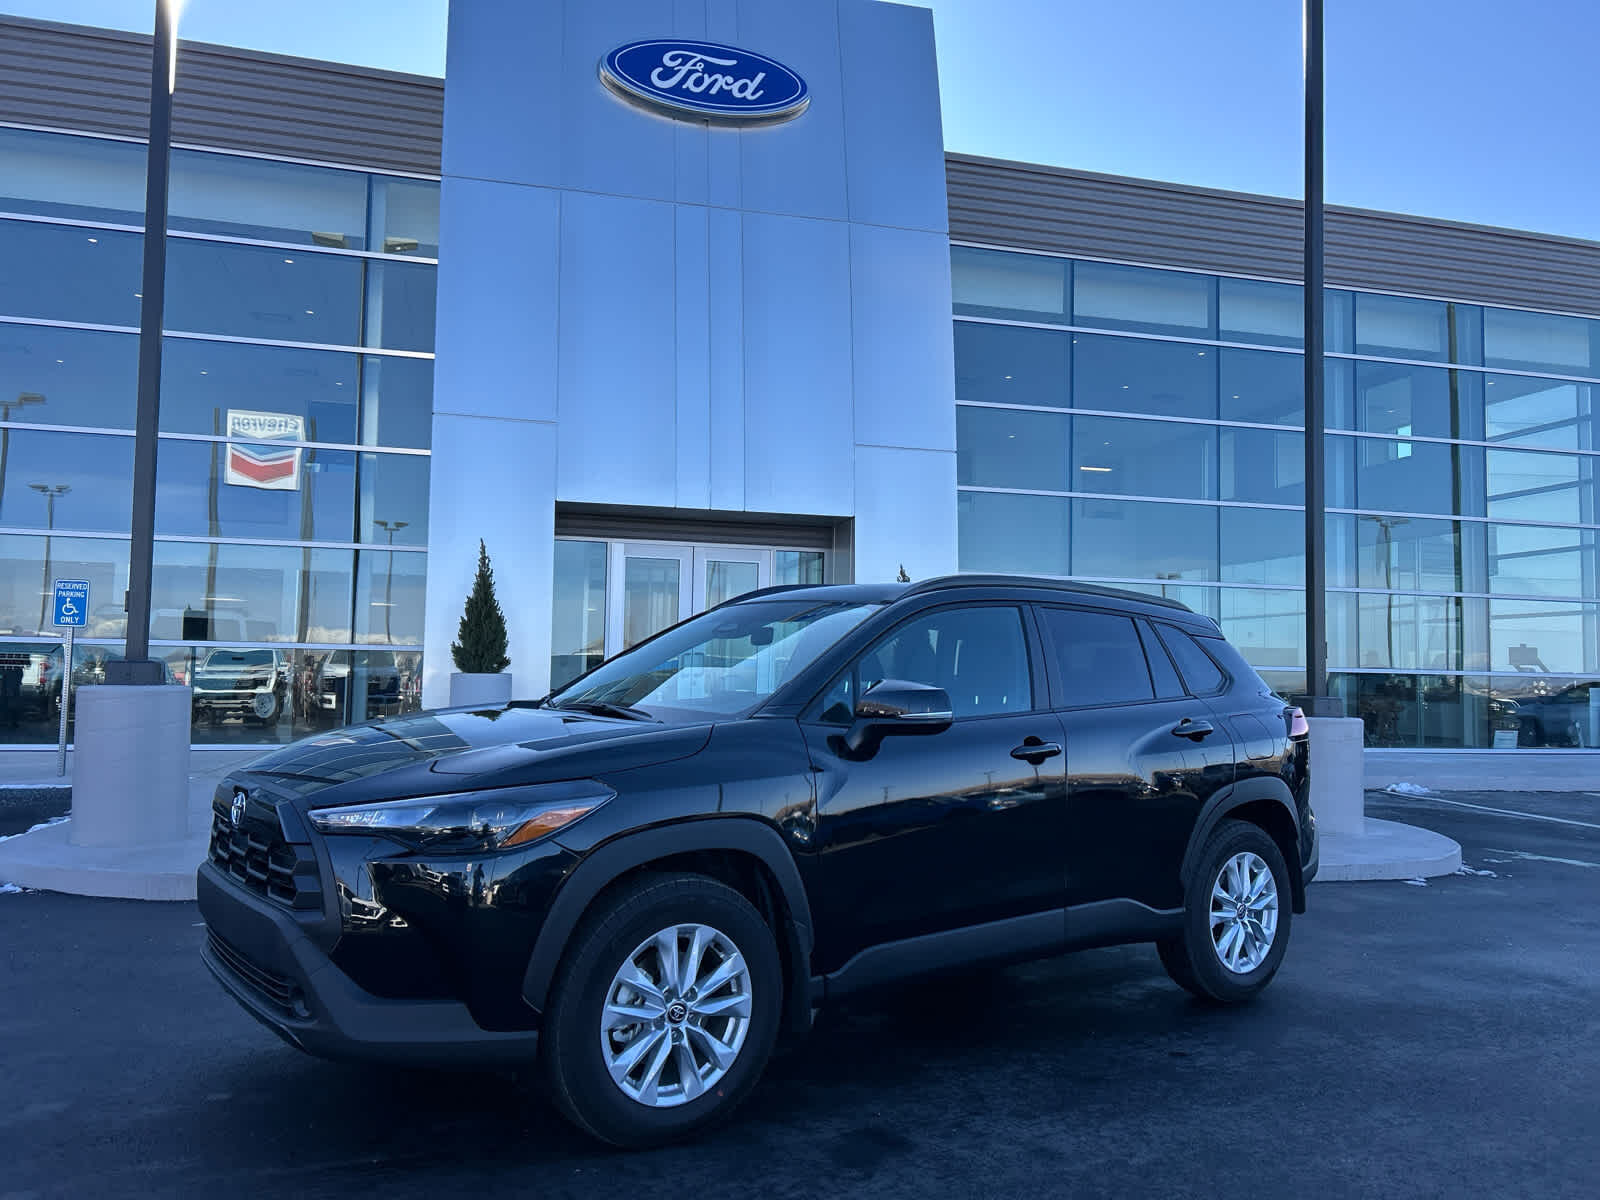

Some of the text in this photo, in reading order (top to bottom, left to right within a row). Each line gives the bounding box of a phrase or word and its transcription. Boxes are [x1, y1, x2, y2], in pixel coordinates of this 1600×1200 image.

[651, 50, 766, 101] Ford
[57, 582, 88, 590] RESERVED
[58, 590, 85, 598] PARKING
